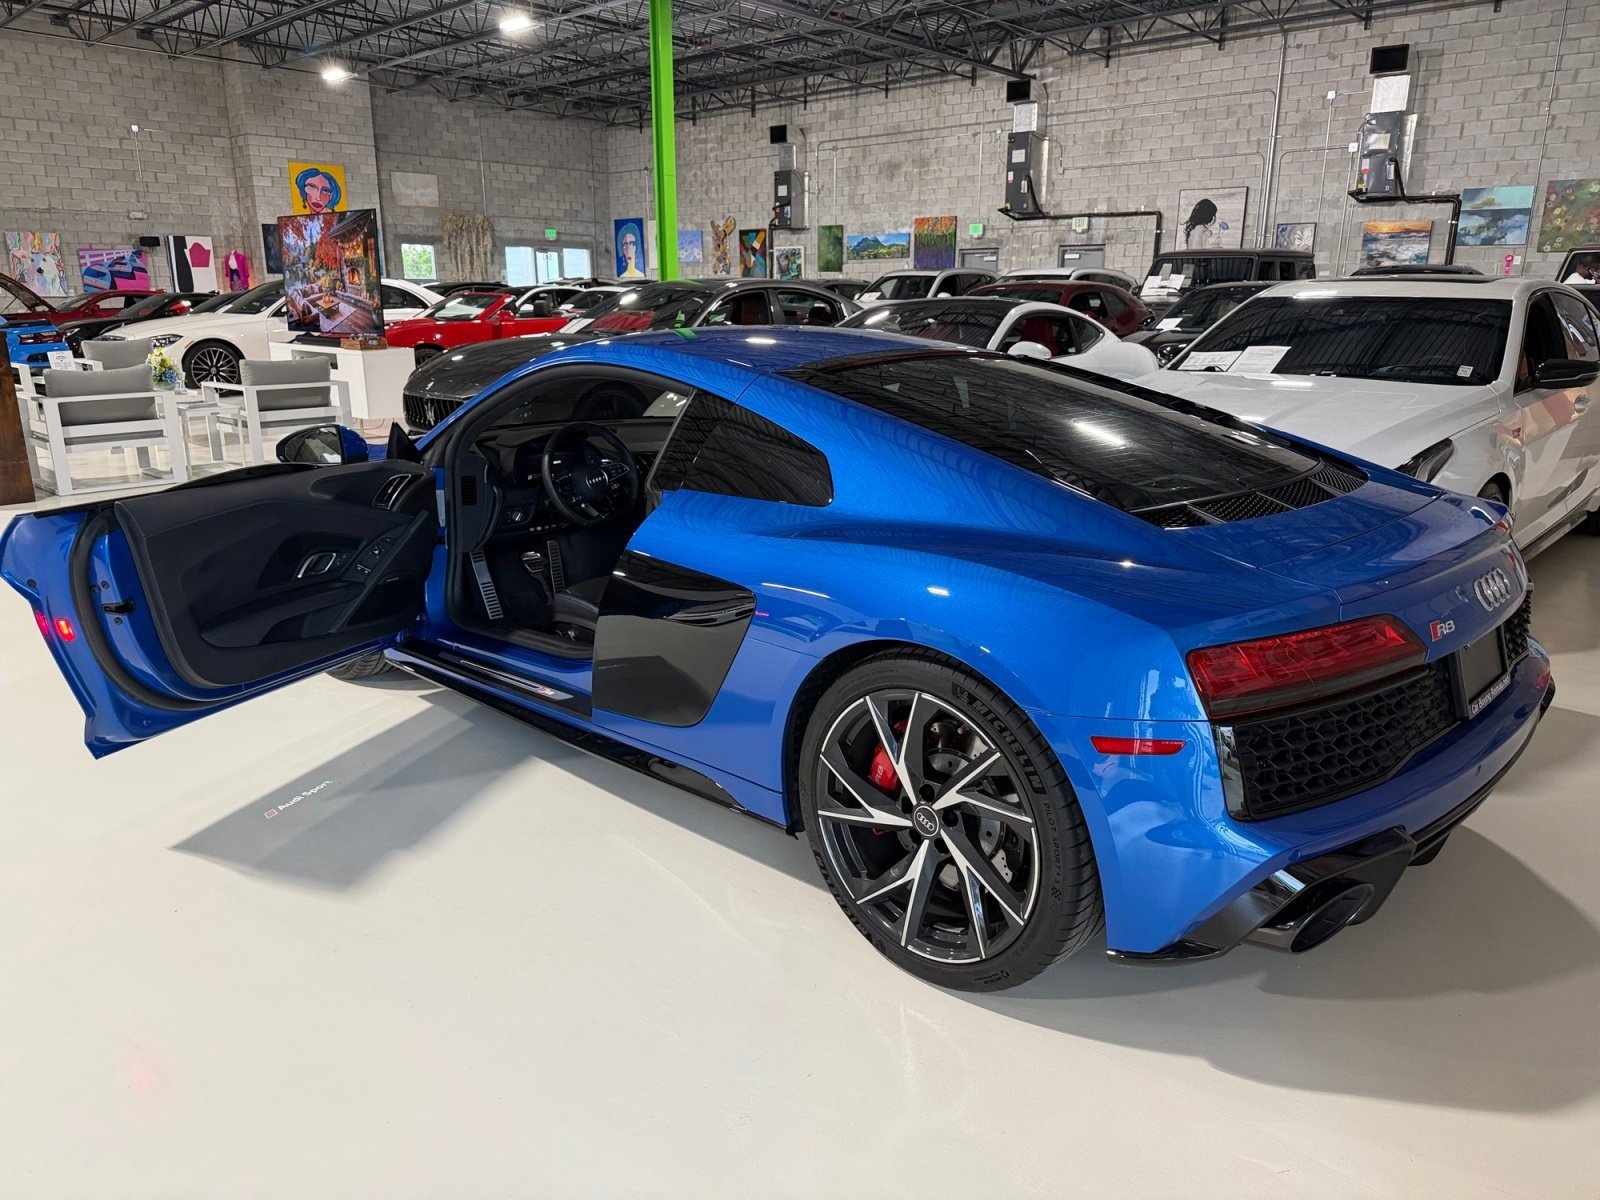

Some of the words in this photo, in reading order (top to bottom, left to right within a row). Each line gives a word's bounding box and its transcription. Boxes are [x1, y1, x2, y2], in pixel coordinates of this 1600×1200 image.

[1074, 218, 1086, 228] EXIT
[1435, 619, 1456, 638] R8
[1471, 703, 1479, 714] Car
[971, 700, 1044, 789] MICHELIN
[278, 795, 304, 811] Audi
[301, 780, 334, 797] Sport
[1043, 802, 1057, 832] PILOT
[1051, 834, 1062, 870] SPORT
